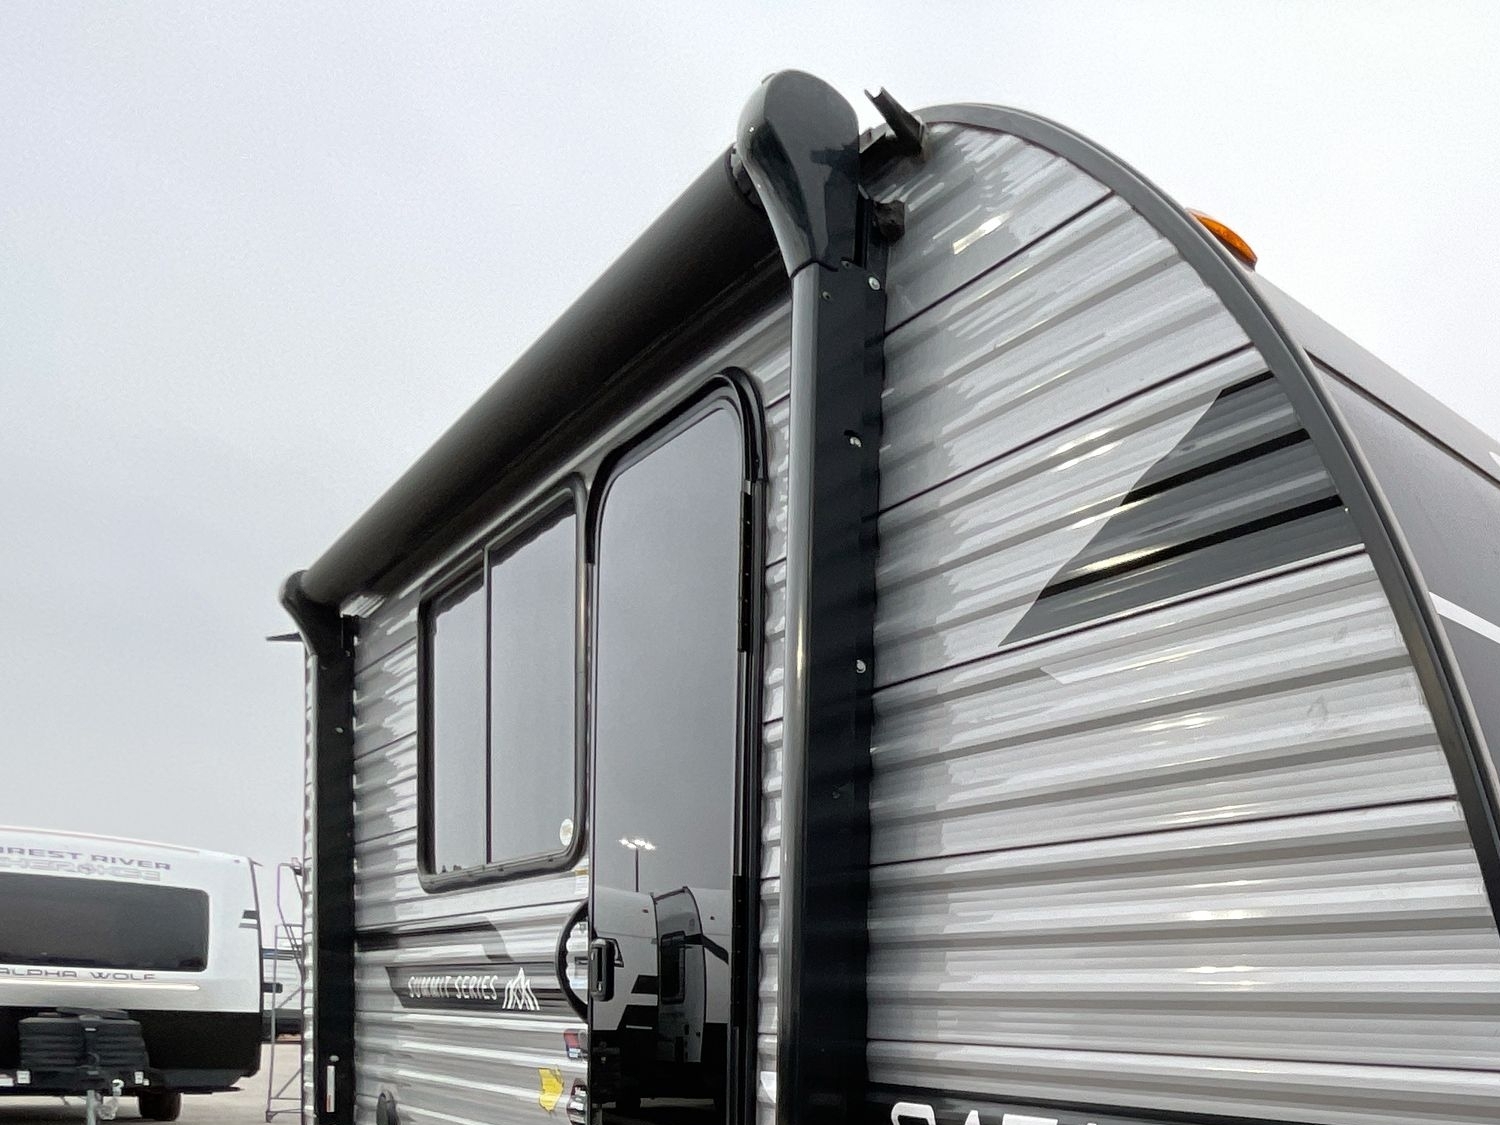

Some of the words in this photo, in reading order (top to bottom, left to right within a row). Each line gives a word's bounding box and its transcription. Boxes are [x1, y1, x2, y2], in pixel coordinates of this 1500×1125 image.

[91, 854, 171, 871] RIVER
[0, 967, 78, 978] ALPHA
[90, 971, 155, 981] WOLF
[454, 975, 498, 1000] SERIES
